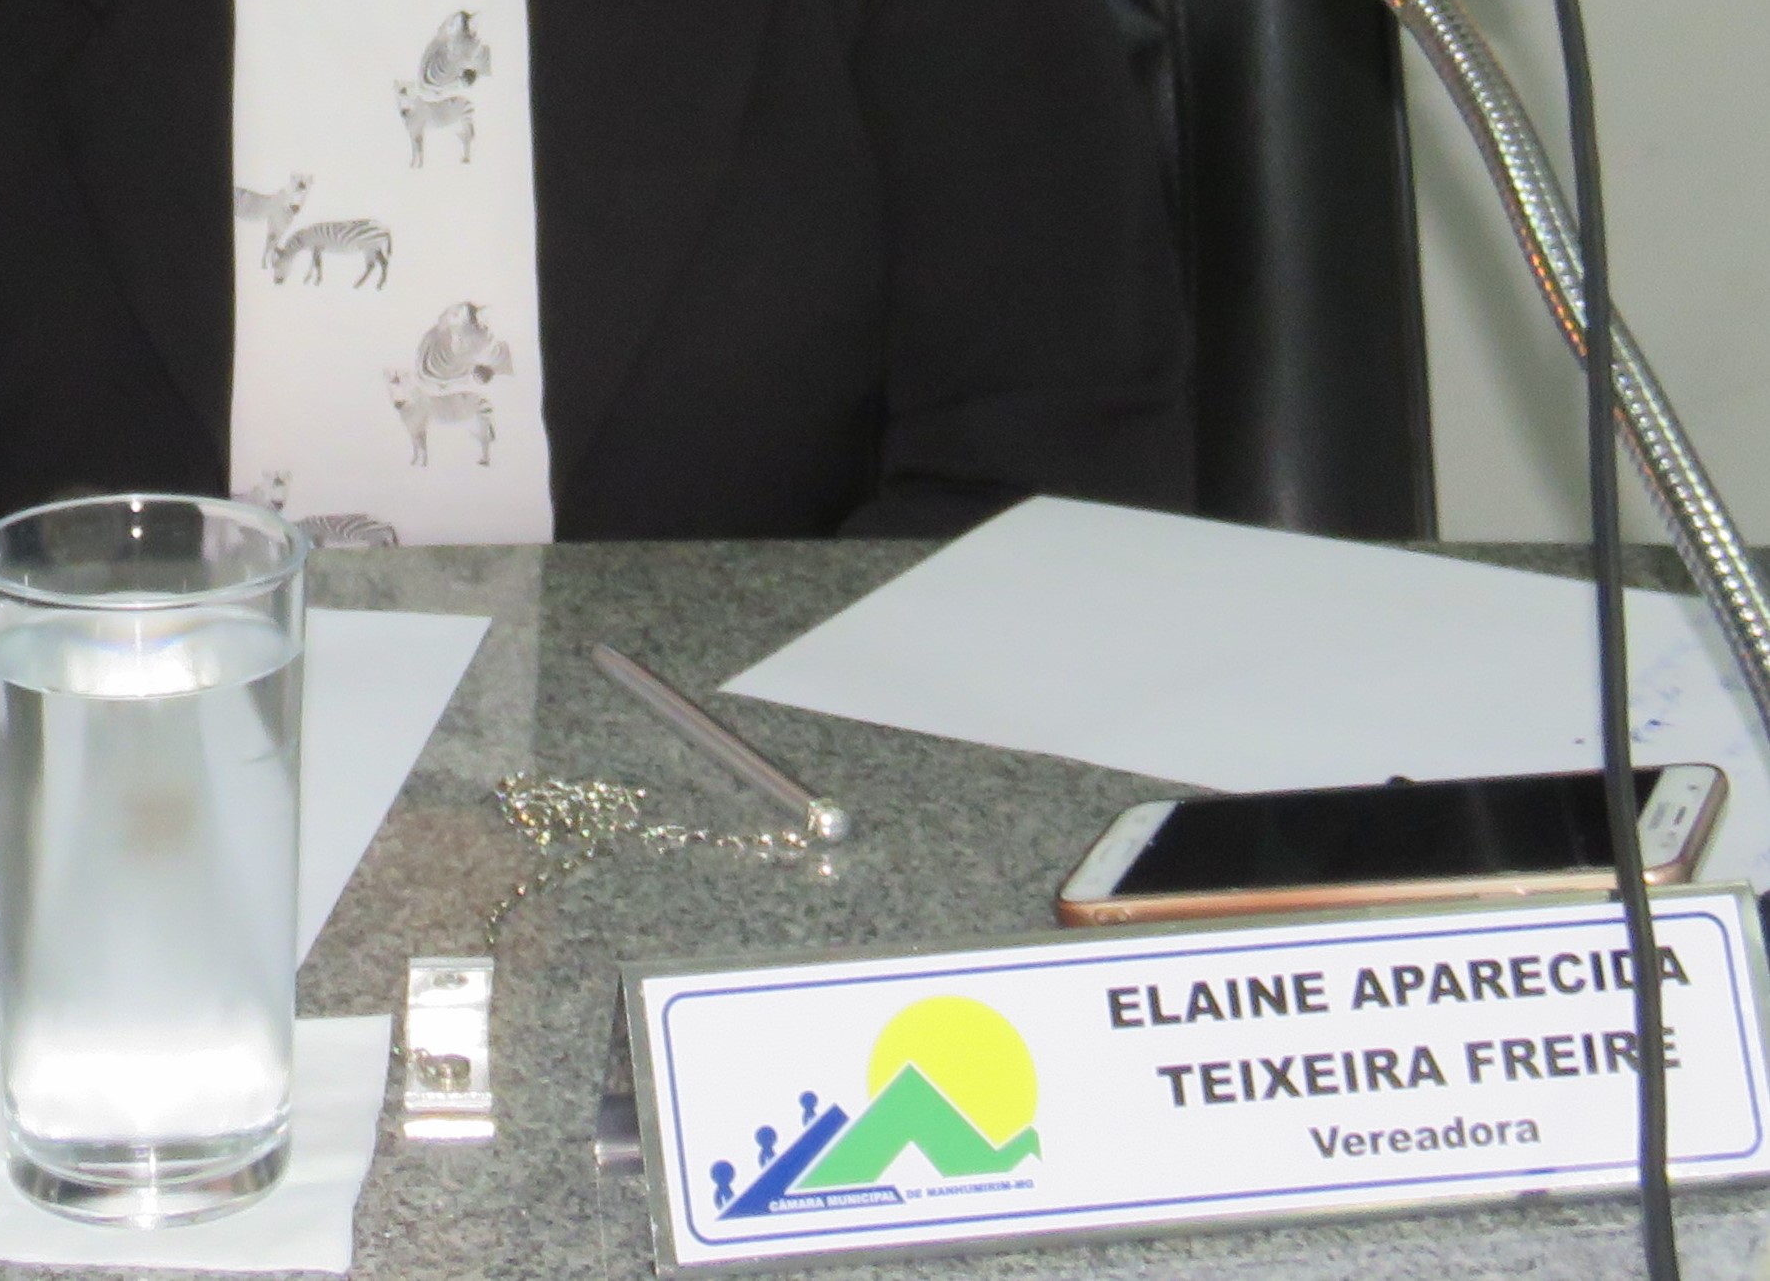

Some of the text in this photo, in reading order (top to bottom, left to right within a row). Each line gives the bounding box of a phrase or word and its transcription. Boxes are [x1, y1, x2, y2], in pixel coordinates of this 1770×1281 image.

[1107, 946, 1690, 1029] ELAINE APARECIDA
[1156, 1046, 1447, 1107] TEIXEIRA
[1308, 1117, 1540, 1159] Vereadora
[826, 1189, 898, 1207] MUNICIPAL
[905, 1188, 923, 1199] DE
